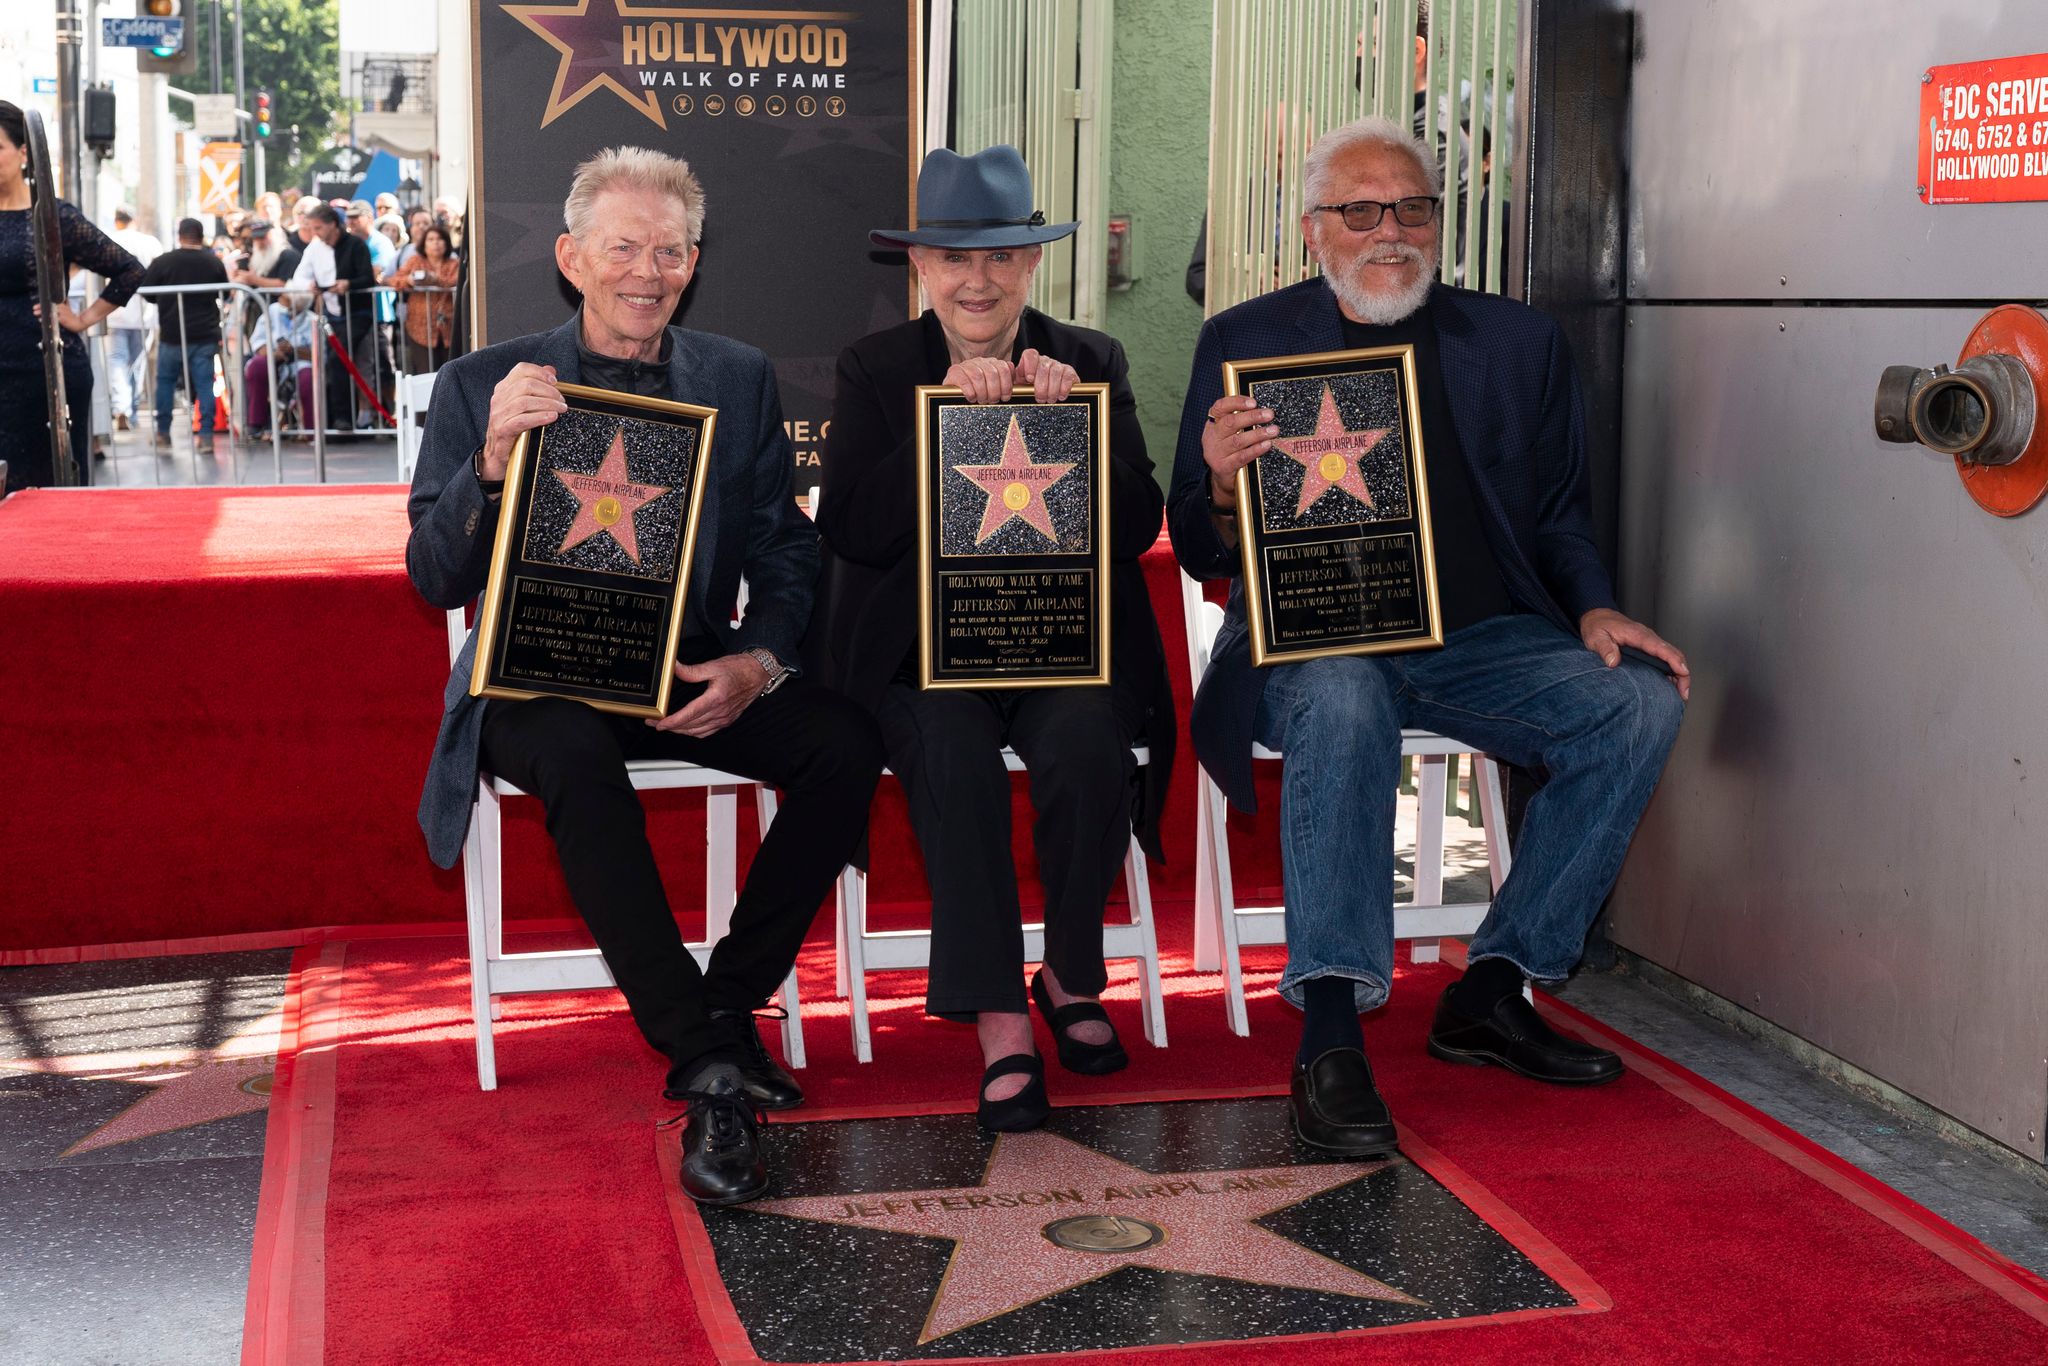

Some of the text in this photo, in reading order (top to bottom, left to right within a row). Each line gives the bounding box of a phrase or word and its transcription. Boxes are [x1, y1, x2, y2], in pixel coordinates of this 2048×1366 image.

[623, 21, 847, 67] HOLLYWOOD
[638, 71, 846, 89] WALK OF FAME
[1943, 76, 2048, 122] FDC SERVE
[1935, 127, 1973, 155] 6740,
[1976, 123, 2013, 150] 6752
[2016, 122, 2028, 147] &
[1936, 153, 2020, 182] HOLLYWOOD
[1291, 434, 1368, 454] JEFFERSON AIRPLANE
[976, 467, 1052, 481] JEFFERSON AIRPLANE
[571, 477, 647, 500] JEFFERSON AIRPLANE
[1273, 537, 1407, 561] HOLLYWOOD WALK OF FAME
[948, 574, 1084, 588] HOLLYWOOD WALK OF FAME
[1280, 559, 1410, 585] JEFFERSON AIRPLANE
[521, 581, 658, 611] HOLLYWOOD WALK OF FAME
[950, 597, 1085, 612] JEFFERSON AIRPLANE
[1279, 587, 1412, 610] HOLLYWOOD WALK OF FAME
[521, 605, 655, 636] JEFFERSON AIRPLANE
[950, 624, 1085, 637] HOLLYWOOD WALK OF FAME
[514, 634, 650, 661] HOLLYWOOD WALK OF FAME
[834, 1173, 1297, 1219] JEFFERSON AIRPLANE
